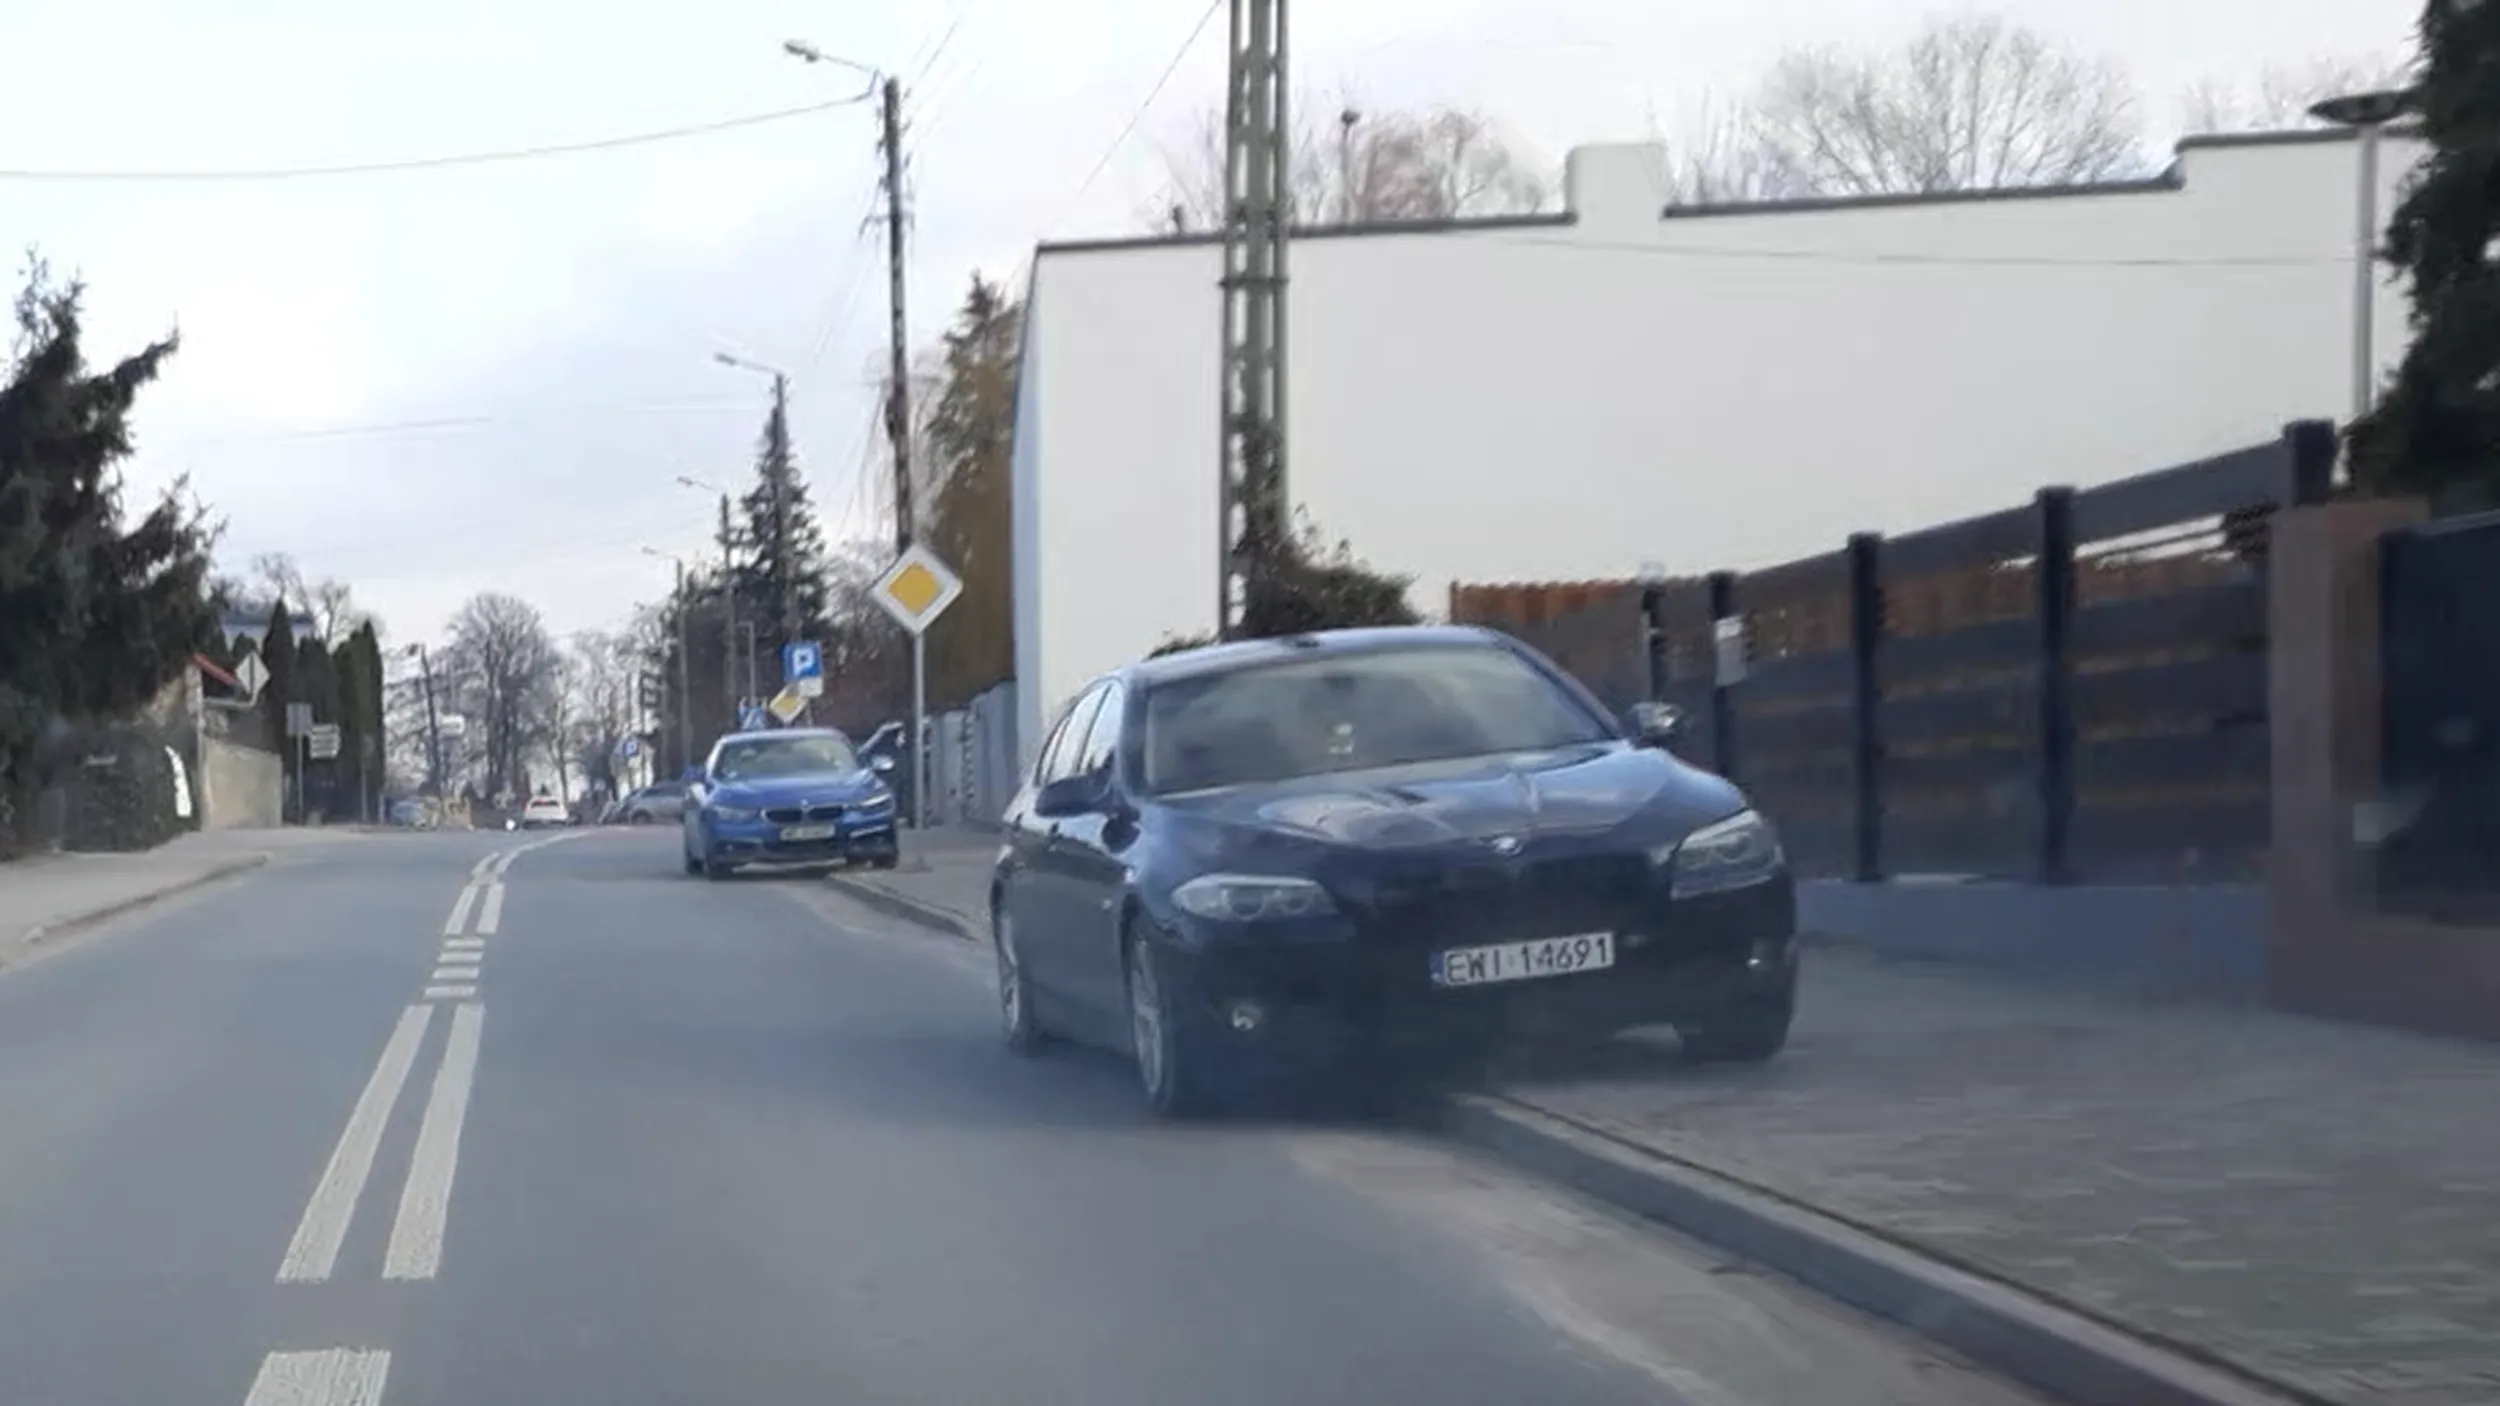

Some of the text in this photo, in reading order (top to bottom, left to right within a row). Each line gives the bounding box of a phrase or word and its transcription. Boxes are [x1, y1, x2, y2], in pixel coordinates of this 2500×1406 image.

[793, 648, 814, 676] P
[1446, 936, 1607, 983] EWI 14691
